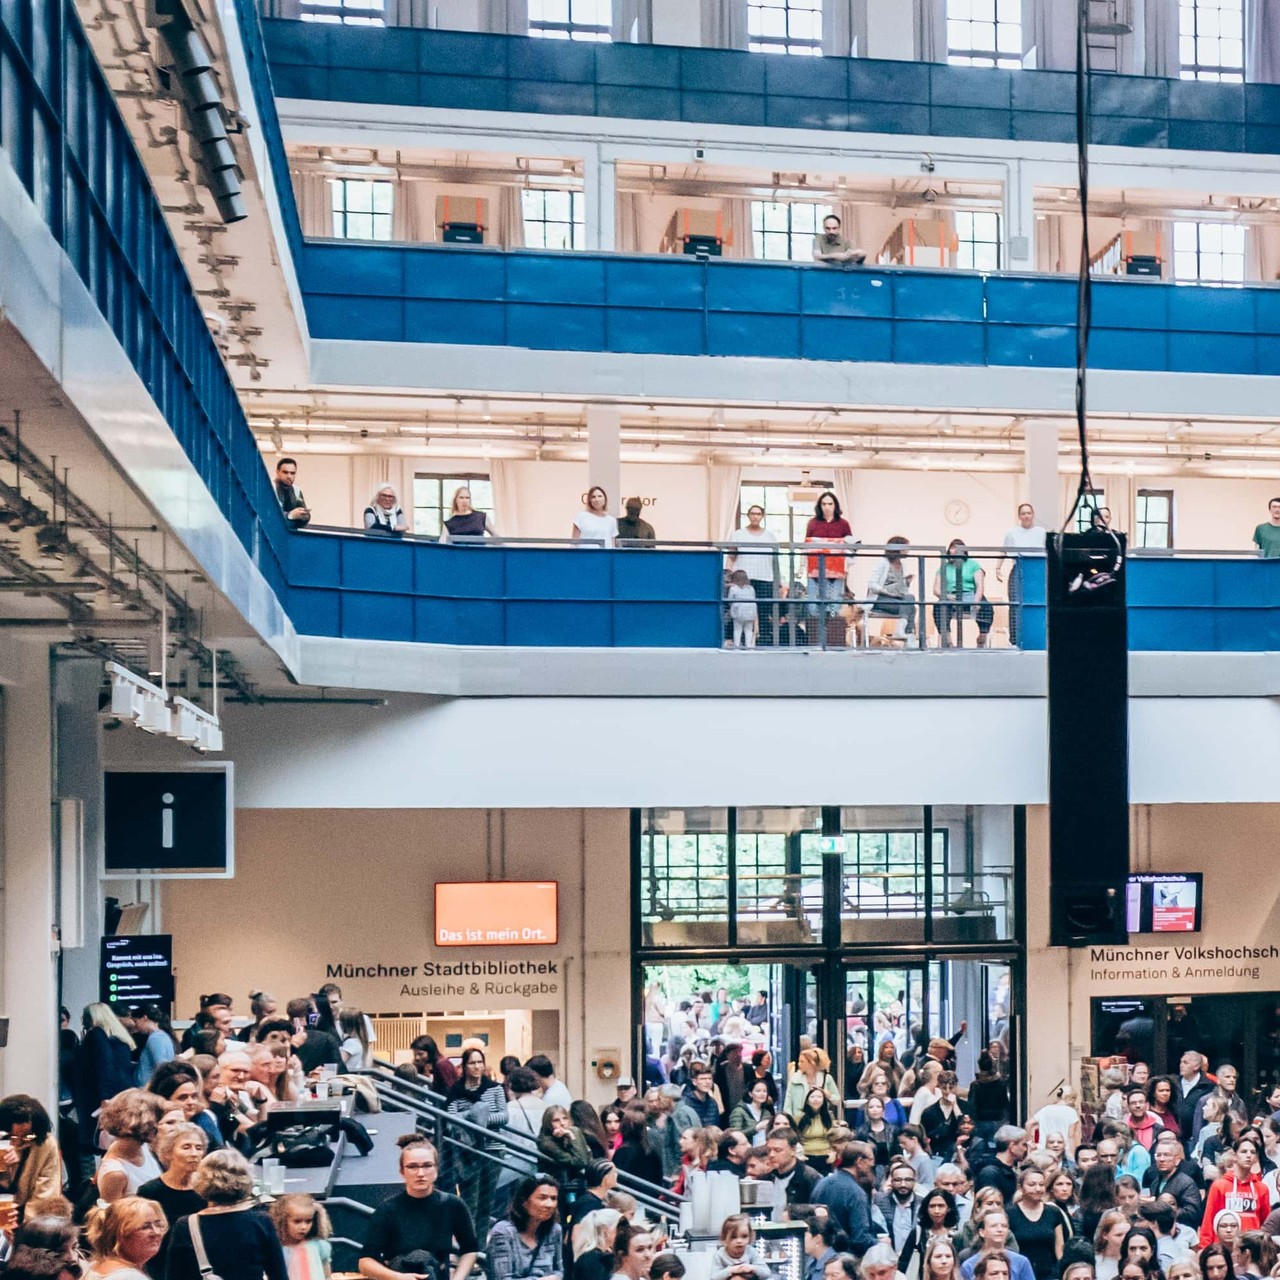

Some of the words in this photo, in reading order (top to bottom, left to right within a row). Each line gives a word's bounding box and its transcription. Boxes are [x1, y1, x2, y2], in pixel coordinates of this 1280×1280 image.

[439, 928, 463, 942] Das
[466, 927, 483, 941] ist
[486, 927, 518, 941] mein
[521, 926, 547, 940] Ort.
[1090, 948, 1169, 962] Münchner
[326, 963, 418, 978] Münchner
[423, 960, 558, 977] Stadtbibliothek
[1090, 967, 1168, 981] Information
[1172, 966, 1181, 979] &
[1185, 965, 1260, 979] Anmeldung
[400, 983, 465, 996] Ausleihe
[469, 982, 480, 995] &
[485, 982, 558, 998] Rückgabe
